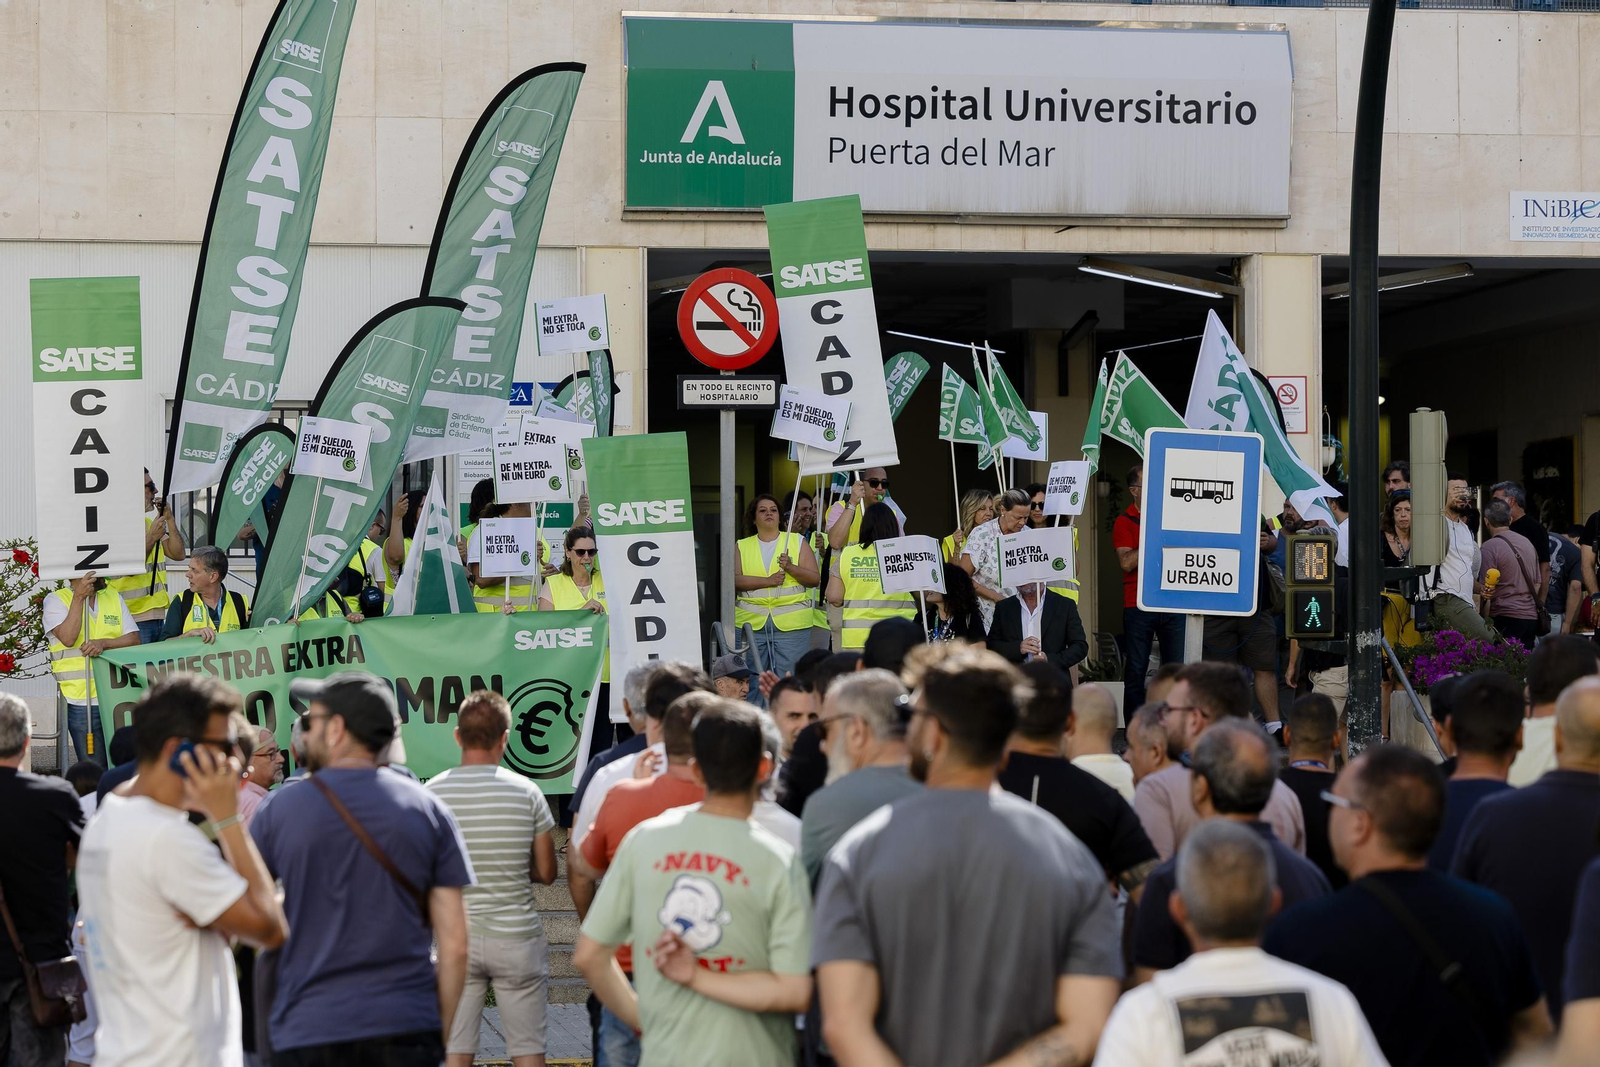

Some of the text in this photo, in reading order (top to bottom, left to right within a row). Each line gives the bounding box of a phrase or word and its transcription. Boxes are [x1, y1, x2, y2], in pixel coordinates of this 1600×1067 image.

[279, 38, 322, 64] SATSE
[828, 85, 1258, 128] Hospital Universitario
[497, 140, 542, 159] SATSE
[828, 136, 1056, 167] Puerta del Mar
[639, 149, 782, 166] Junta de Andalucía
[1523, 199, 1600, 218] INiBIC
[780, 258, 865, 289] SATSE
[542, 313, 579, 326] MI EXTRA
[543, 321, 586, 335] NO SE TOCA
[39, 346, 136, 373] SATSE
[361, 372, 410, 397] SATSE
[430, 368, 506, 391] CÁDIZ
[686, 383, 773, 391] EN TODO EL RECINTO
[811, 299, 865, 468] CADZ
[699, 393, 759, 401] HOSPITALARIO
[451, 412, 486, 424] Sindicato
[783, 400, 834, 421] ES MI SUELDO,
[450, 421, 460, 429] de
[461, 421, 492, 435] Enferme
[781, 410, 836, 431] ES MI DERECHO
[415, 425, 444, 435] SATSE
[448, 429, 471, 440] Cádiz
[303, 433, 354, 449] ES MI SUELDO,
[524, 431, 557, 445] EXTRAS
[183, 448, 217, 460] SATSE
[301, 443, 356, 459] ES MI DERECHO
[232, 436, 276, 495] SATSE
[500, 463, 511, 473] DE
[513, 462, 522, 472] MI
[242, 450, 287, 506] Cádiz
[501, 470, 546, 482] NI UN EURO
[1049, 477, 1056, 485] DE
[1058, 485, 1072, 493] EURO
[597, 499, 687, 527] SATSE
[486, 535, 516, 545] MI EXTRA
[486, 544, 520, 554] NO SE TOCA
[1005, 546, 1042, 560] MI EXTRA
[851, 556, 879, 568] SAT
[884, 552, 937, 565] POR NUESTRAS
[1005, 553, 1049, 568] NO SE TOCA
[1185, 554, 1217, 569] BUS
[885, 563, 915, 575] PAGAS
[1167, 570, 1234, 586] URBANO
[514, 627, 593, 651] SATSE
[281, 634, 365, 673] EXTRA
[663, 852, 743, 886] NAVY
